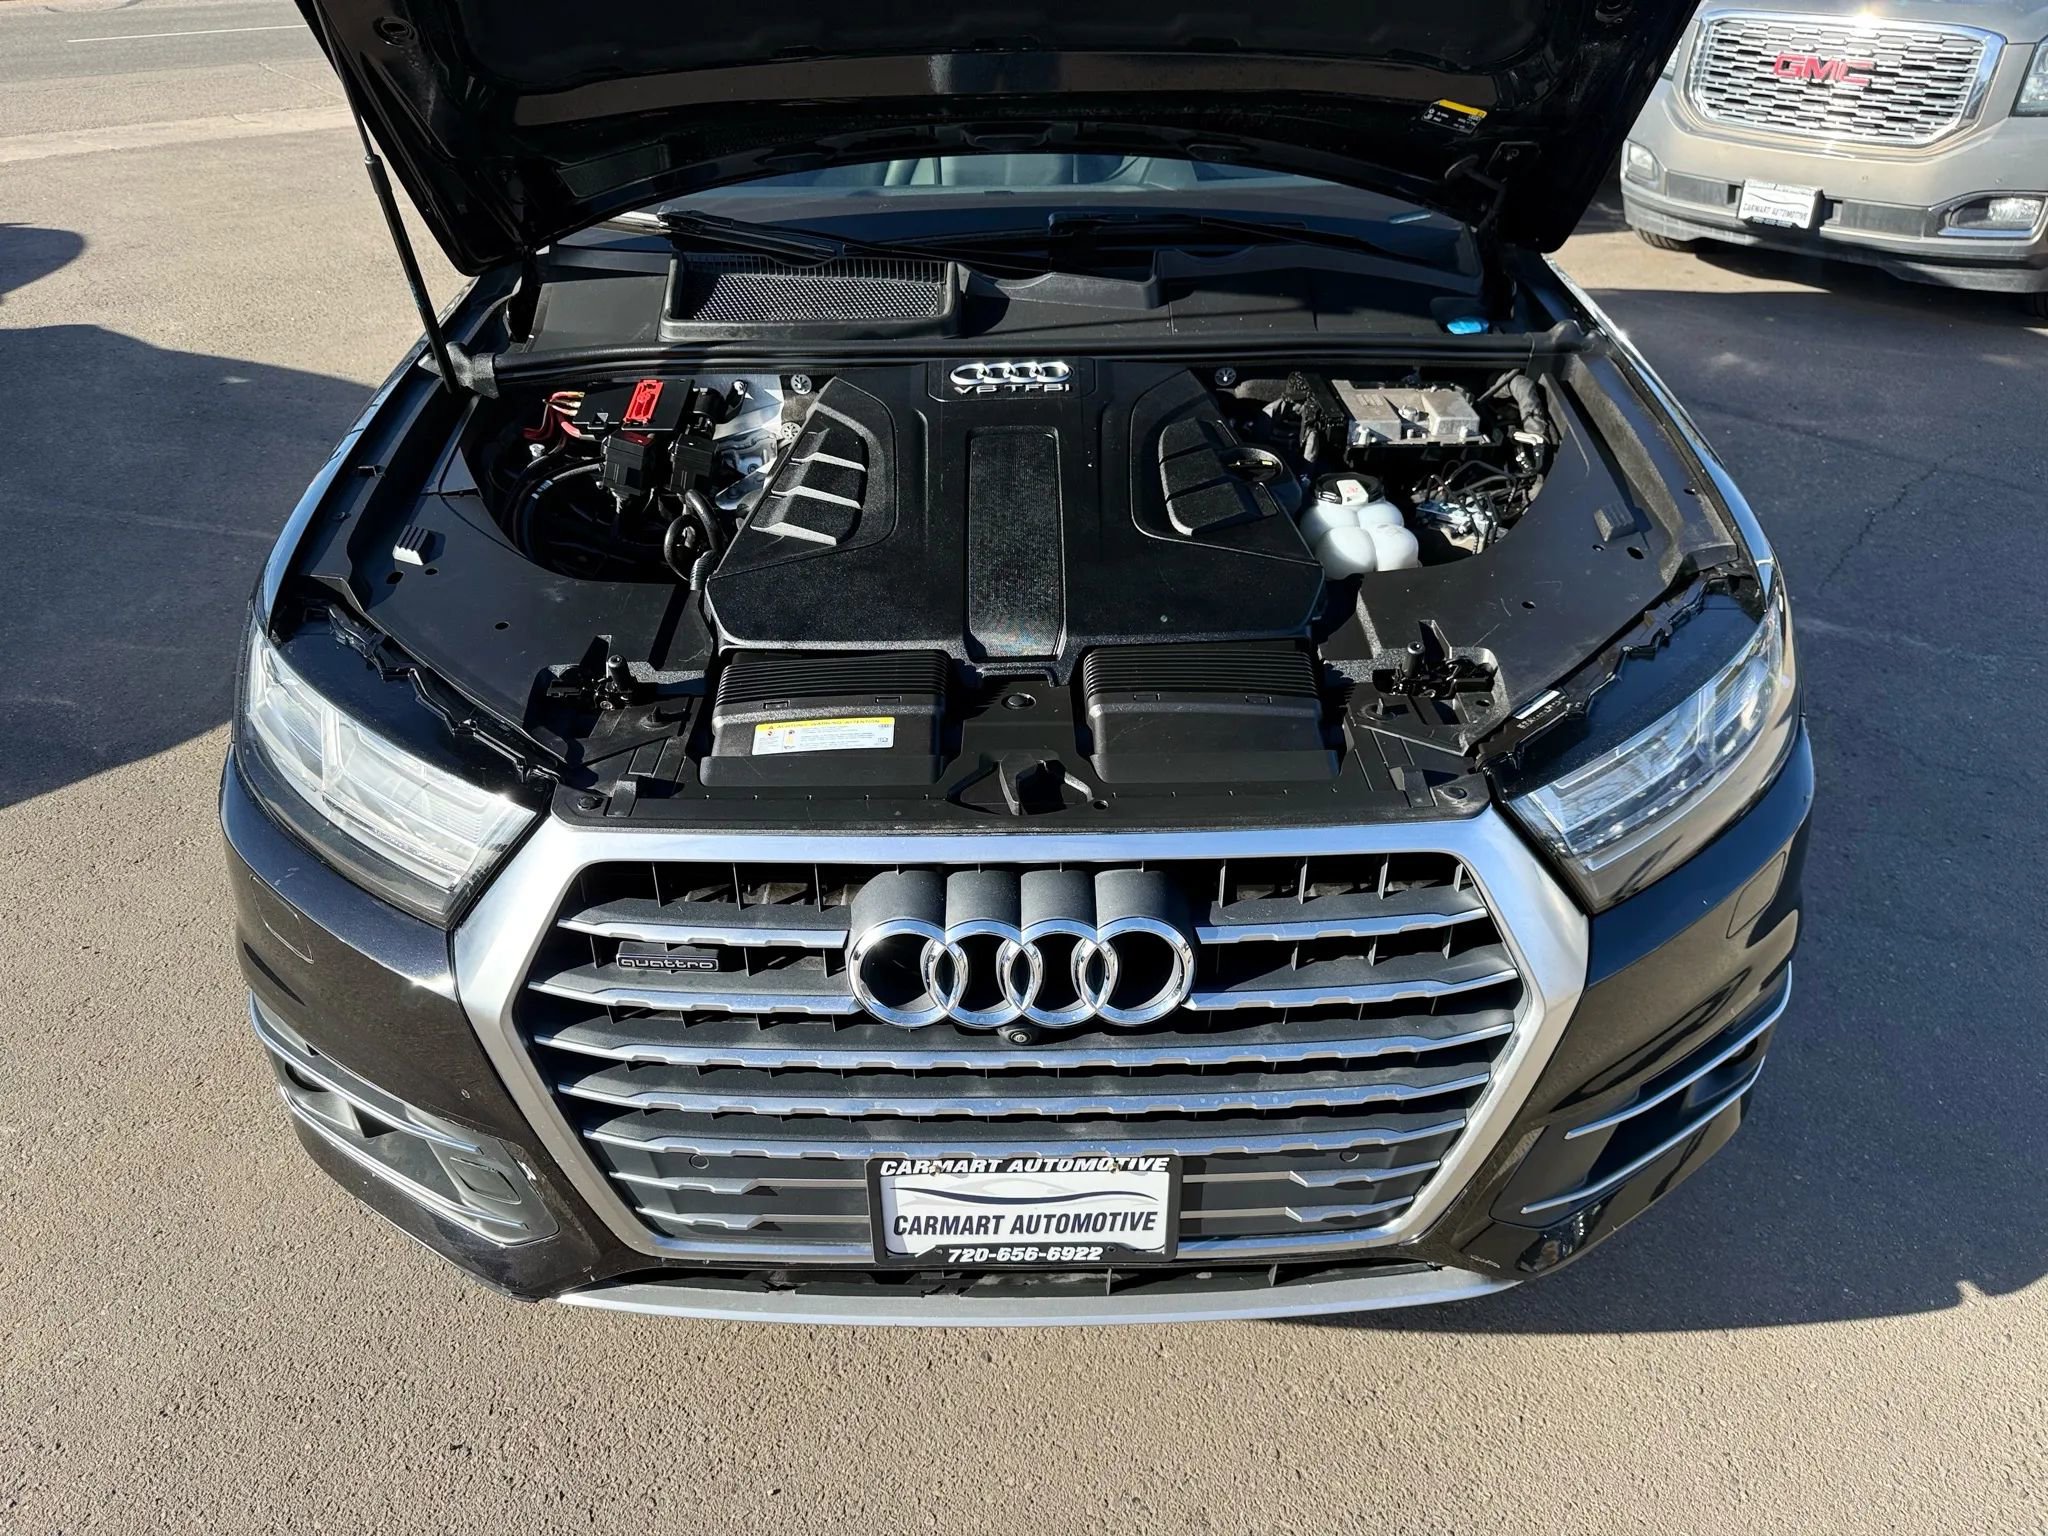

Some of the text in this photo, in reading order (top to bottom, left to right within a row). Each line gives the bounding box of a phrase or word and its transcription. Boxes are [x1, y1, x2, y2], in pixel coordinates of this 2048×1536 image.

[1774, 52, 1875, 87] GMC
[621, 959, 714, 970] quattro
[880, 1157, 1170, 1176] CARMART AUTOMOTIVE
[894, 1211, 1158, 1236] CARMART AUTOMOTIVE
[947, 1246, 1104, 1263] 720-656-6922
